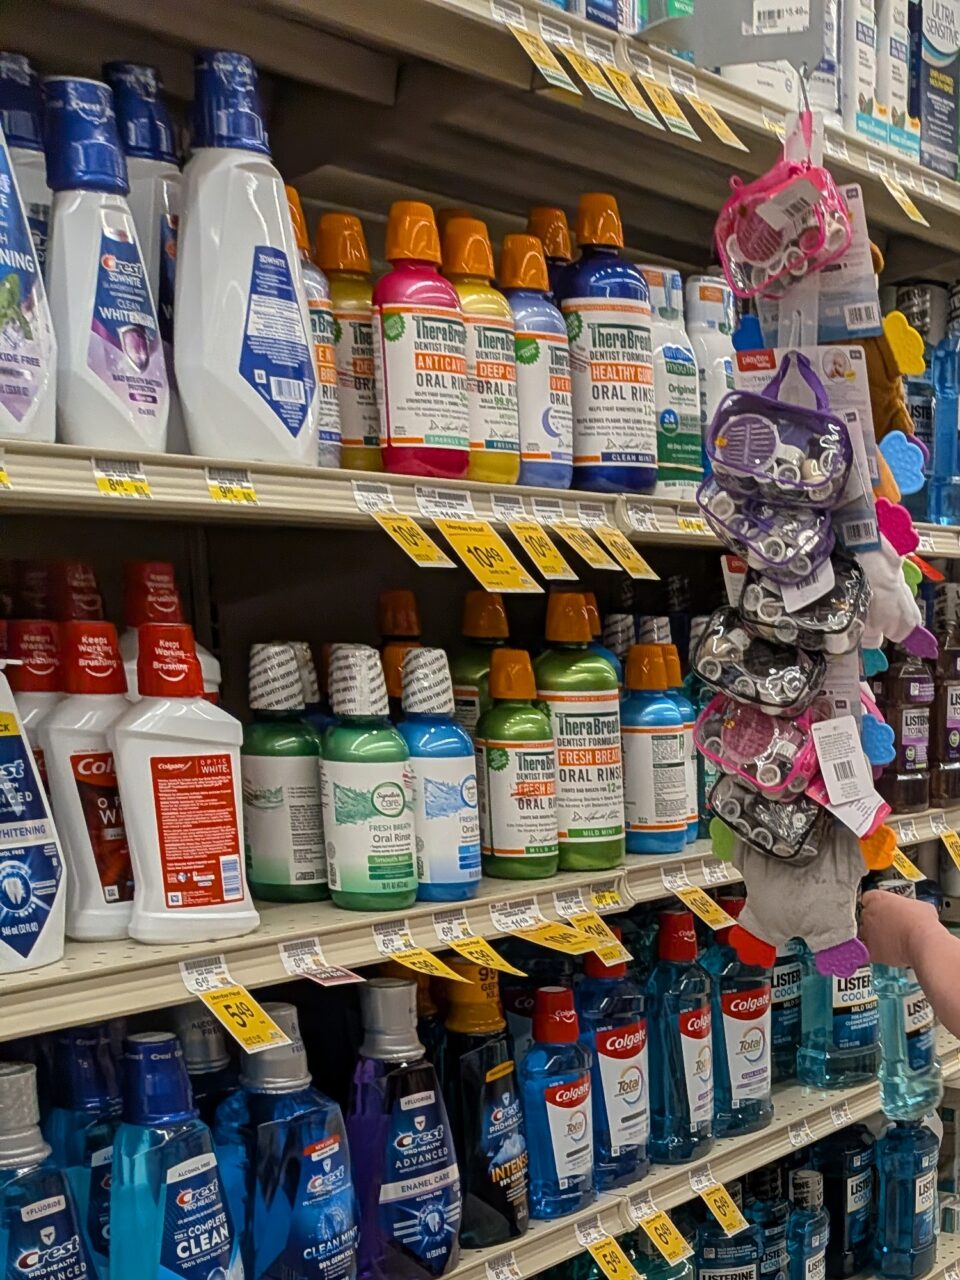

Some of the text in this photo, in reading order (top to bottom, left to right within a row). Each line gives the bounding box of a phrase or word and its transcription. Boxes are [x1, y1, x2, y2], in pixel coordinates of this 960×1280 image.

[931, 1, 955, 24] ULTRA
[101, 254, 144, 276] Crest
[414, 341, 443, 351] DENTIST
[476, 350, 501, 360] DENTIST
[590, 351, 620, 361] DENTIST
[480, 364, 505, 378] DEEP
[593, 364, 636, 381] HEALTHY
[416, 373, 447, 389] ORAL
[477, 380, 505, 396] ORAL
[592, 385, 626, 401] ORAL
[668, 384, 696, 395] Original
[391, 525, 425, 548] 1049
[524, 534, 549, 559] 1049
[466, 546, 504, 568] 1049
[81, 636, 108, 645] Keeps
[159, 639, 180, 650] Keeps
[77, 644, 113, 655] Working
[78, 658, 117, 669] Brushing
[152, 662, 190, 673] Brushing
[557, 737, 587, 748] DENTIST
[559, 750, 593, 764] FRESH
[157, 762, 186, 771] Colgate
[200, 764, 230, 774] WHITE
[516, 772, 536, 781] DENTIST
[559, 768, 593, 783] ORAL
[518, 797, 546, 810] ORAL
[369, 823, 412, 832] FRESH BREATH
[582, 827, 616, 837] MILD MINT
[372, 832, 411, 843] Oral Rinse
[468, 949, 497, 965] 599
[730, 994, 771, 1013] Colgate
[842, 989, 866, 1002] COOL
[223, 1002, 255, 1029] 549
[606, 1029, 646, 1052] Colgate
[739, 1038, 762, 1054] Total
[617, 1076, 640, 1092] Total
[555, 1083, 590, 1103] Colgate
[490, 1098, 520, 1124] Crest
[394, 1124, 444, 1149] Crest
[395, 1147, 449, 1169] ADVANCED
[306, 1165, 345, 1193] Crest
[401, 1172, 450, 1193] ENAMEL CARE
[175, 1180, 219, 1207] Crest
[713, 1195, 730, 1218] 649
[188, 1214, 227, 1239] COMPLETE
[654, 1222, 672, 1245] 649
[176, 1223, 231, 1259] CLEAN
[303, 1225, 358, 1260] CLEAN MINT
[17, 1235, 80, 1272] Crest
[602, 1252, 620, 1274] 549
